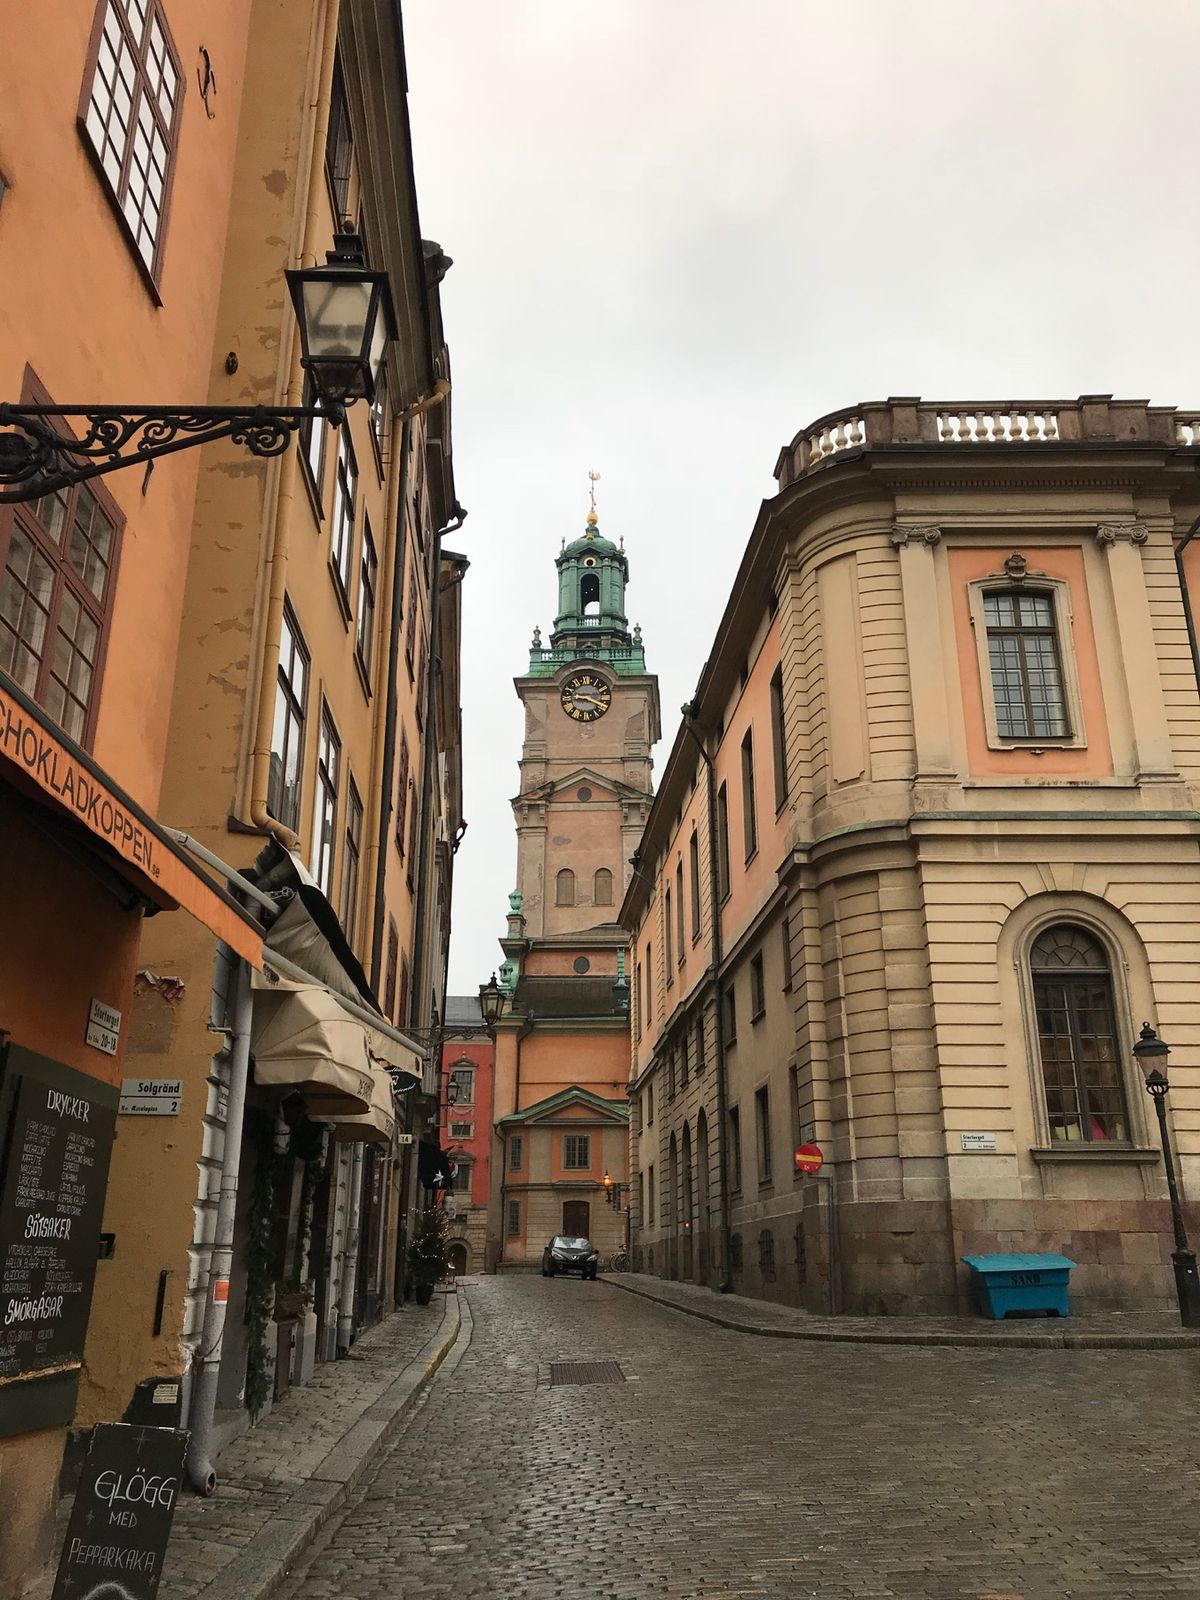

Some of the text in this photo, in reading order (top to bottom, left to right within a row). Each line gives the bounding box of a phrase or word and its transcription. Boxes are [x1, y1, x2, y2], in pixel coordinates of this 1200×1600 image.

[94, 1004, 120, 1028] Stortorget
[137, 1081, 180, 1095] Solgränd
[47, 1089, 90, 1123] DRYCKER
[171, 1101, 178, 1112] 2
[401, 1135, 409, 1143] 14
[24, 1212, 72, 1241] SÖTSAKER
[1010, 1273, 1041, 1286] SAND
[4, 1291, 64, 1325] SMÖRGÅSAR
[94, 1467, 177, 1511] GLÖGG
[109, 1511, 138, 1528] MED
[67, 1537, 156, 1573] PEPPARKAKA
